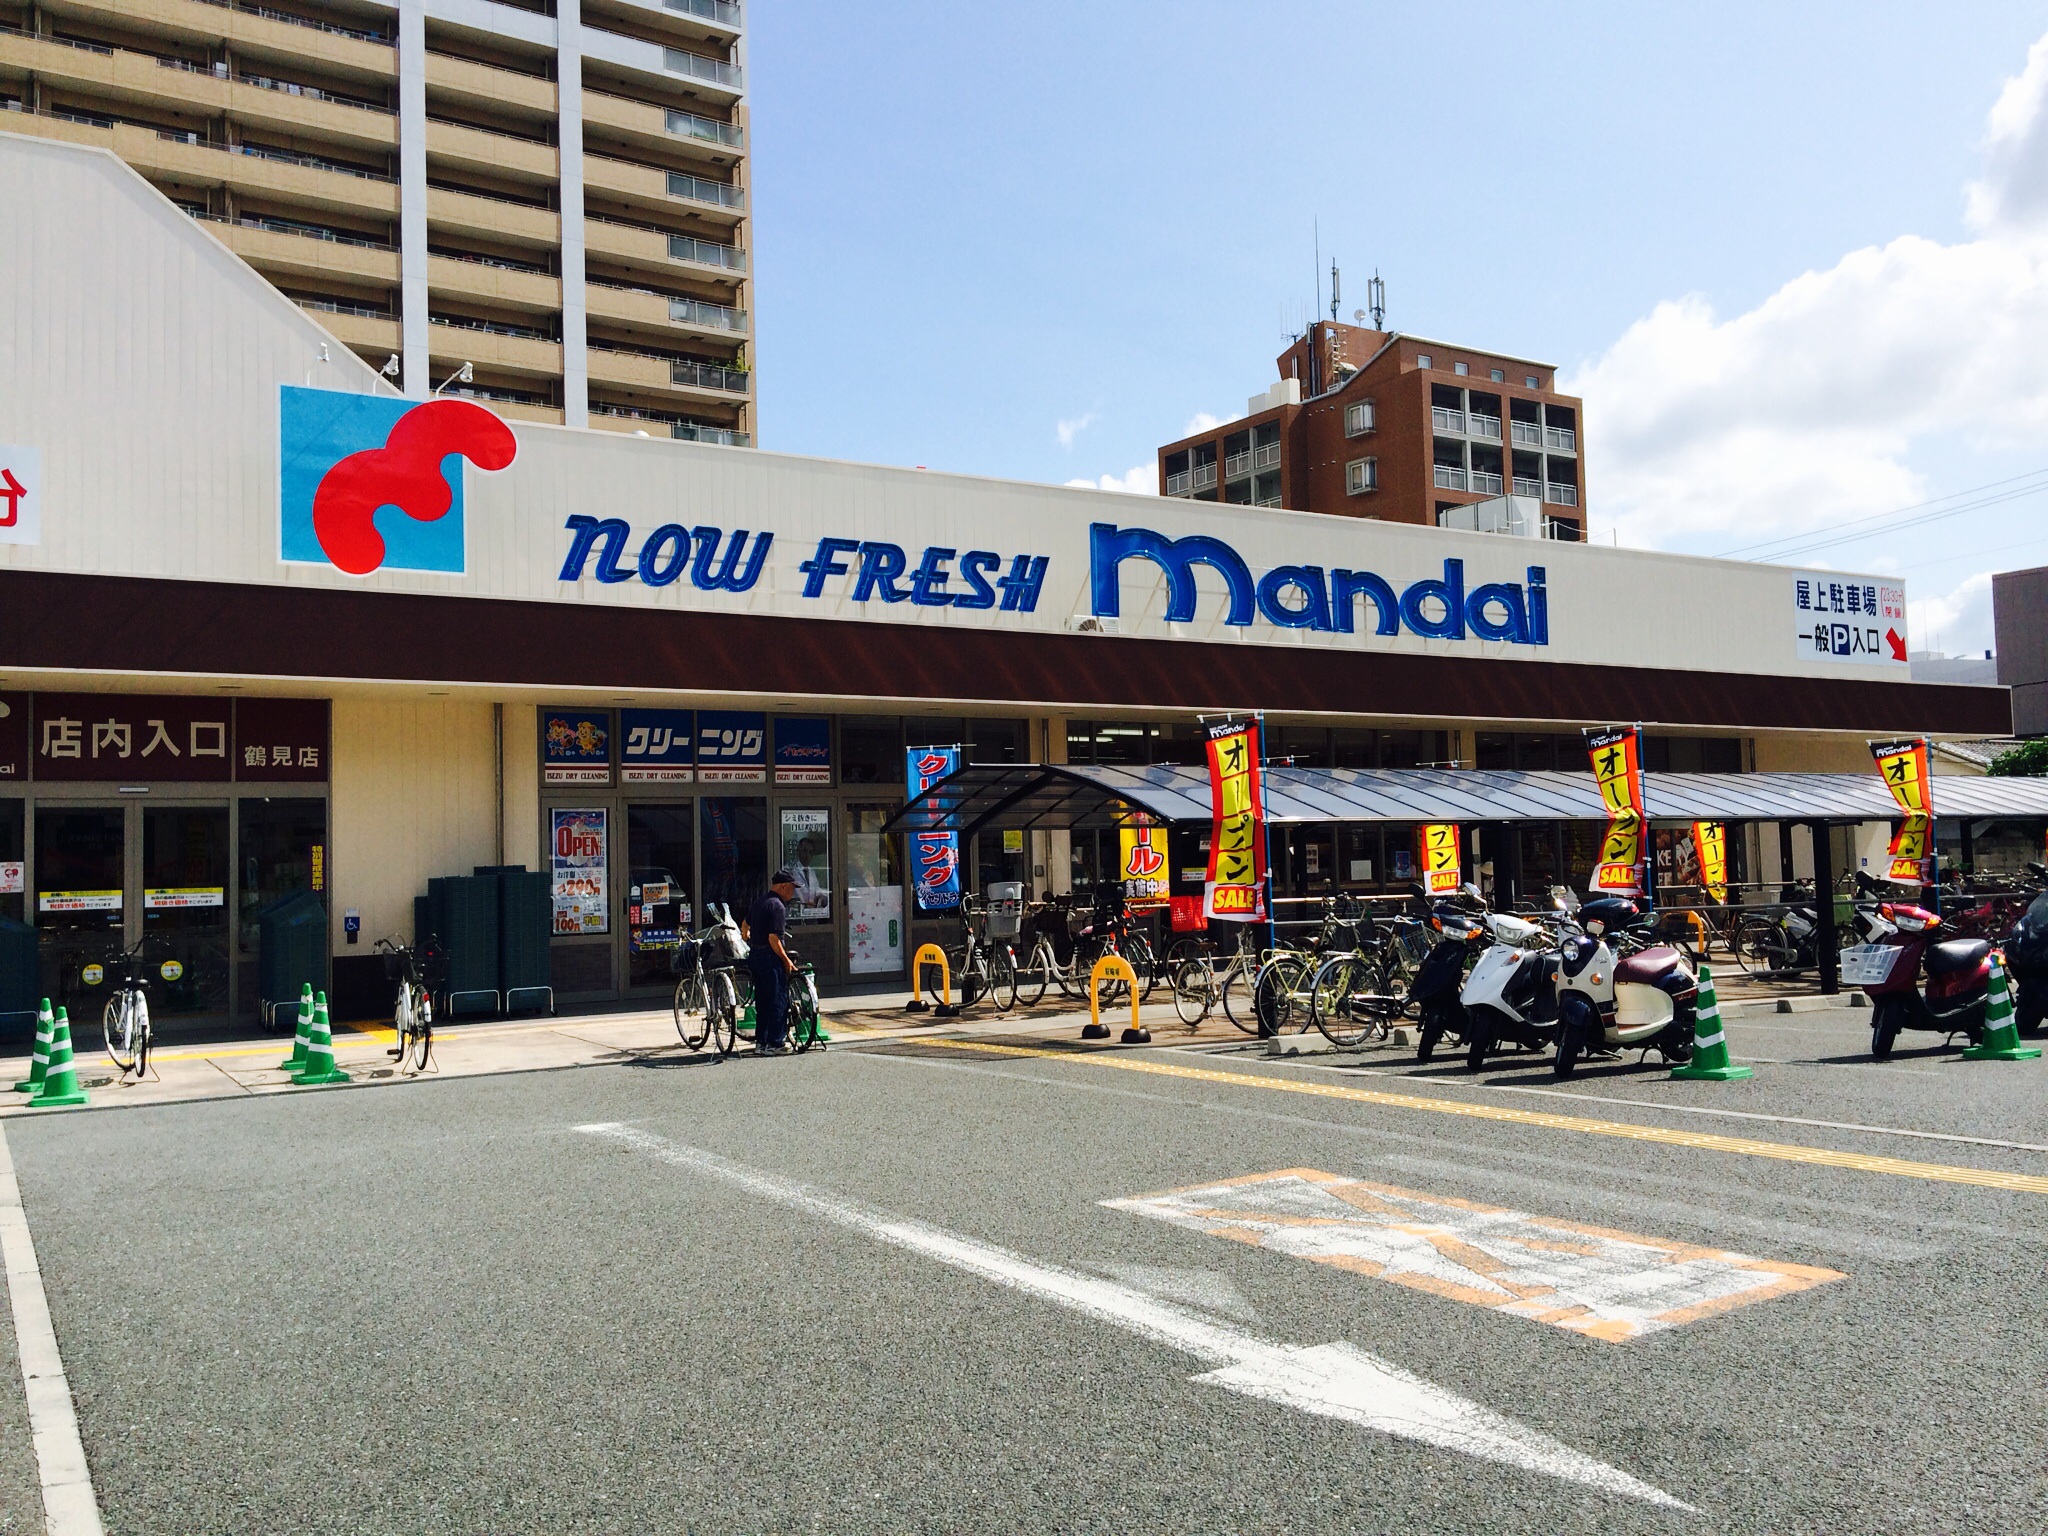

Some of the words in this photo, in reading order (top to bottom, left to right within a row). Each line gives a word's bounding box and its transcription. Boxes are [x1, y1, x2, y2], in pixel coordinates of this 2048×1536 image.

[800, 537, 1050, 612] FRESH
[1089, 522, 1549, 646] mandai
[1796, 580, 1877, 616] 屋上駐車場
[40, 716, 226, 758] 店内入口
[244, 745, 319, 768] 鶴見店
[547, 772, 563, 780] ISEZU
[565, 772, 578, 780] DRY
[580, 772, 608, 780] CLEANING
[628, 772, 645, 780] ISEZU
[646, 772, 658, 780] DRY
[660, 772, 687, 780] CLEANING
[1223, 738, 1250, 881] オープン
[557, 826, 602, 858] OPEN
[1125, 879, 1158, 897] 実施中
[1431, 873, 1458, 889] SALE
[1213, 889, 1254, 909] SALE
